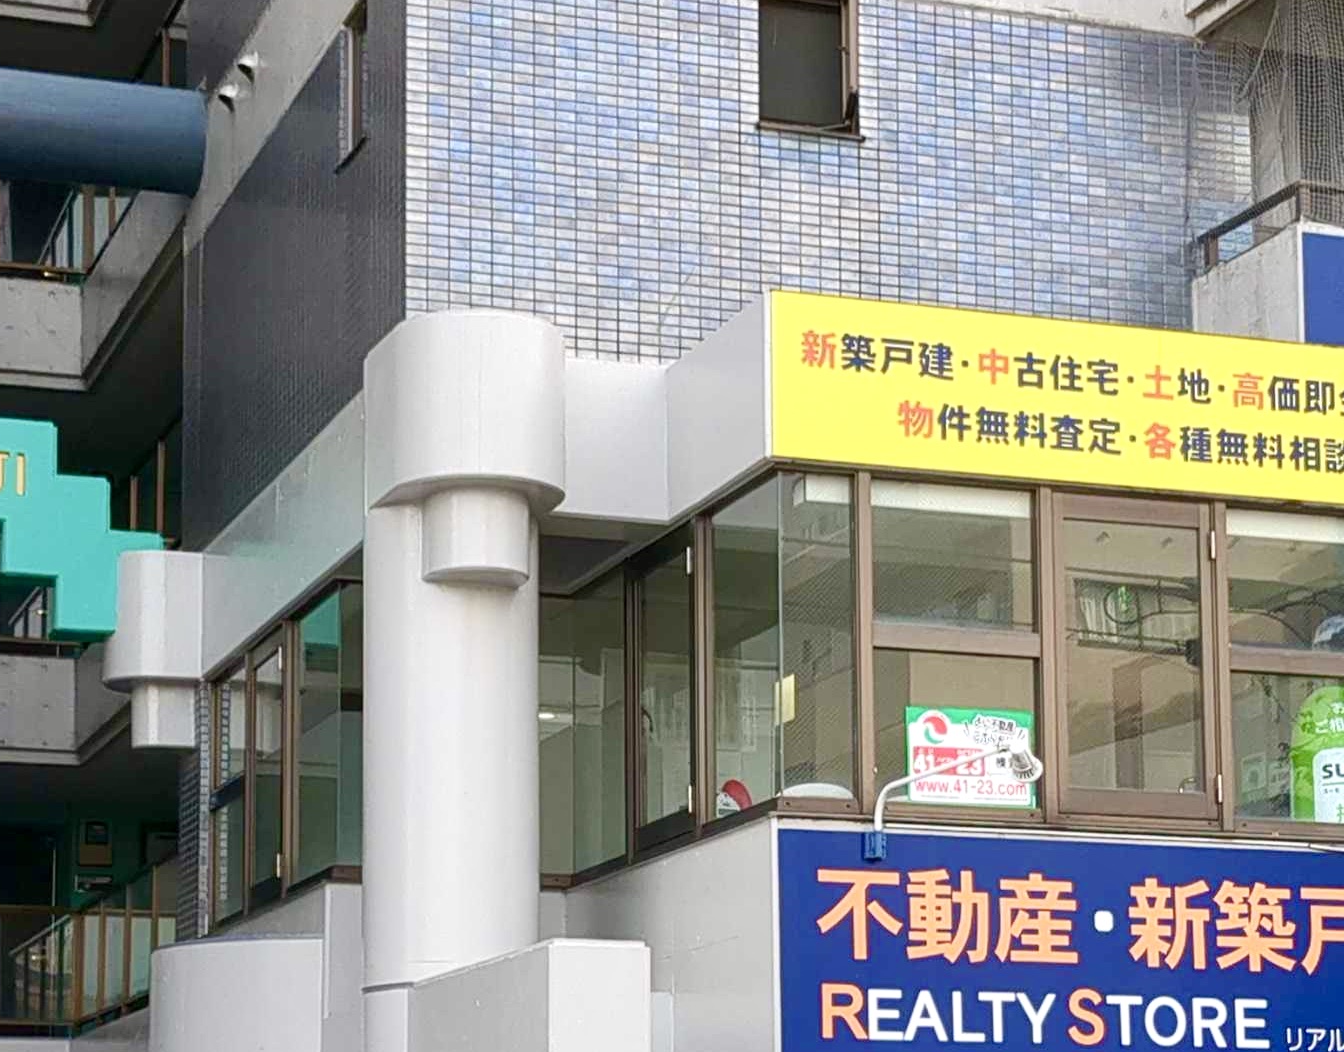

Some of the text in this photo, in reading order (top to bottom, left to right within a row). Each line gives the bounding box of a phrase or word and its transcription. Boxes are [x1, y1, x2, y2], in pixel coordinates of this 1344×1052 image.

[915, 779, 1027, 796] www.41-23.com
[821, 983, 1270, 1049] REALTY STORE
